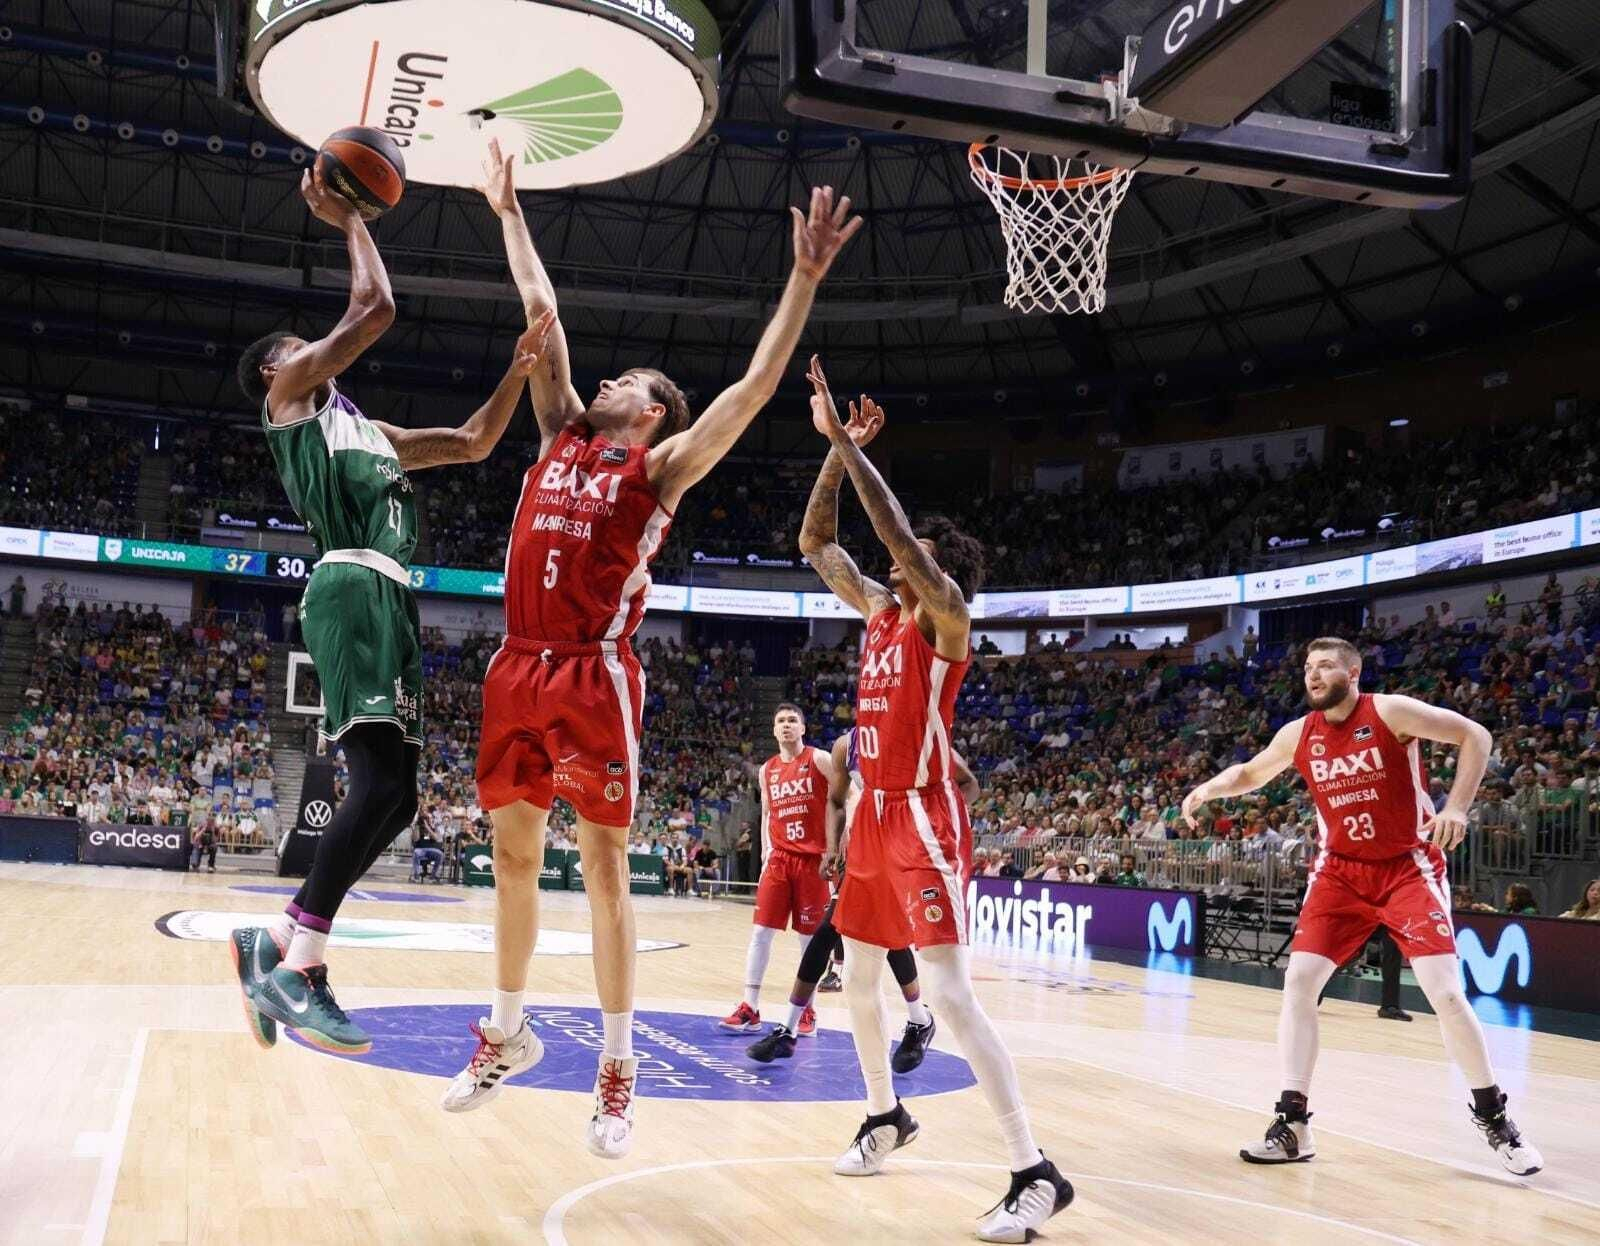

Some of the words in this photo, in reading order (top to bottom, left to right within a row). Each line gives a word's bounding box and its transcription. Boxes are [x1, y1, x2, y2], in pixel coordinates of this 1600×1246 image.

[539, 460, 623, 503] BAXI
[532, 512, 592, 540] MANRESA
[132, 547, 186, 563] UNICAJA
[224, 553, 252, 572] 37
[543, 549, 561, 590] 5
[862, 644, 902, 678] AXI
[1310, 747, 1384, 783] BAXI
[770, 777, 813, 800] BAXI
[1317, 770, 1387, 793] CLIMATIZACIÓN
[1328, 788, 1379, 809] MANRESA
[786, 821, 805, 841] 55
[1343, 812, 1375, 841] 23
[89, 829, 180, 849] endesa
